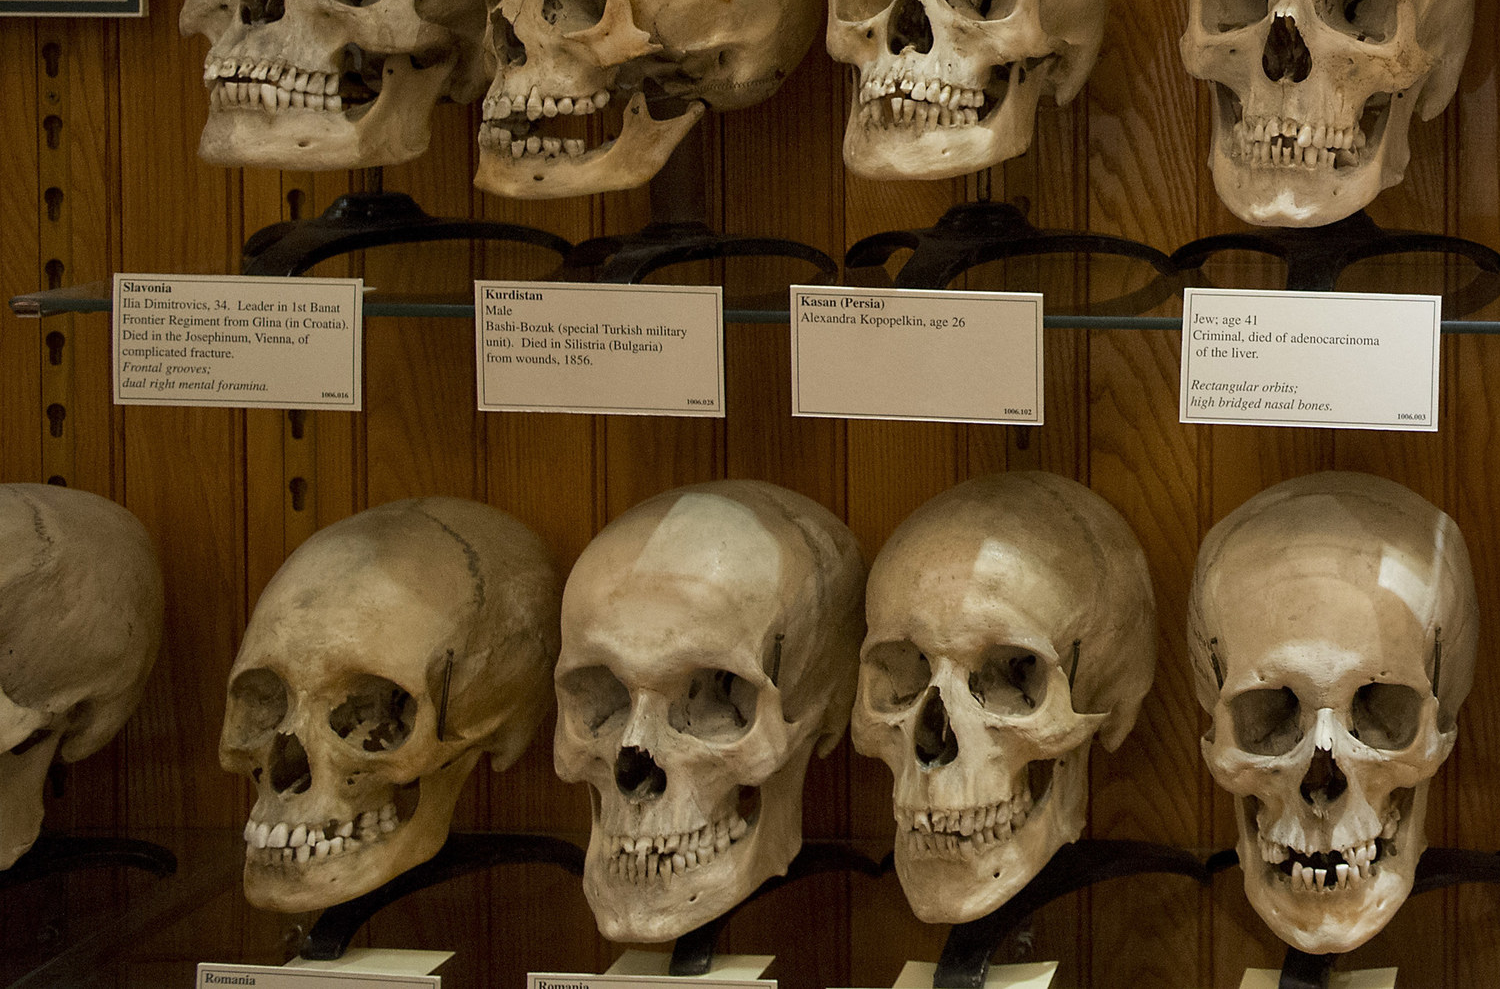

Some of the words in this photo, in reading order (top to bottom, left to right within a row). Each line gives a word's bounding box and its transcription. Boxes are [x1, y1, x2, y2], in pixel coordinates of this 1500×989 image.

[122, 281, 172, 293] Slavonia
[485, 288, 543, 301] Kurdistan
[122, 297, 141, 309] Ilia
[143, 297, 210, 311] Dimitrovics,
[213, 299, 230, 311] 34.
[237, 300, 275, 312] Leader
[277, 301, 288, 312] in
[292, 301, 306, 313] 1st
[309, 301, 340, 313] Banat
[800, 296, 837, 308] Kasan
[839, 296, 885, 310] (Persia)
[485, 305, 512, 316] Male
[800, 312, 857, 324] Alexandra
[859, 313, 926, 328] Kopopelkin,
[929, 318, 948, 330] age
[951, 316, 966, 328] 26
[1192, 313, 1218, 325] Jew;
[1221, 316, 1241, 327] age
[1244, 314, 1257, 326] 41
[486, 352, 512, 363] from
[515, 354, 560, 365] wounds,
[564, 354, 593, 366] 1856.
[1190, 379, 1260, 394] Rectangular
[1261, 381, 1298, 394] orbits;
[204, 972, 256, 986] Romania
